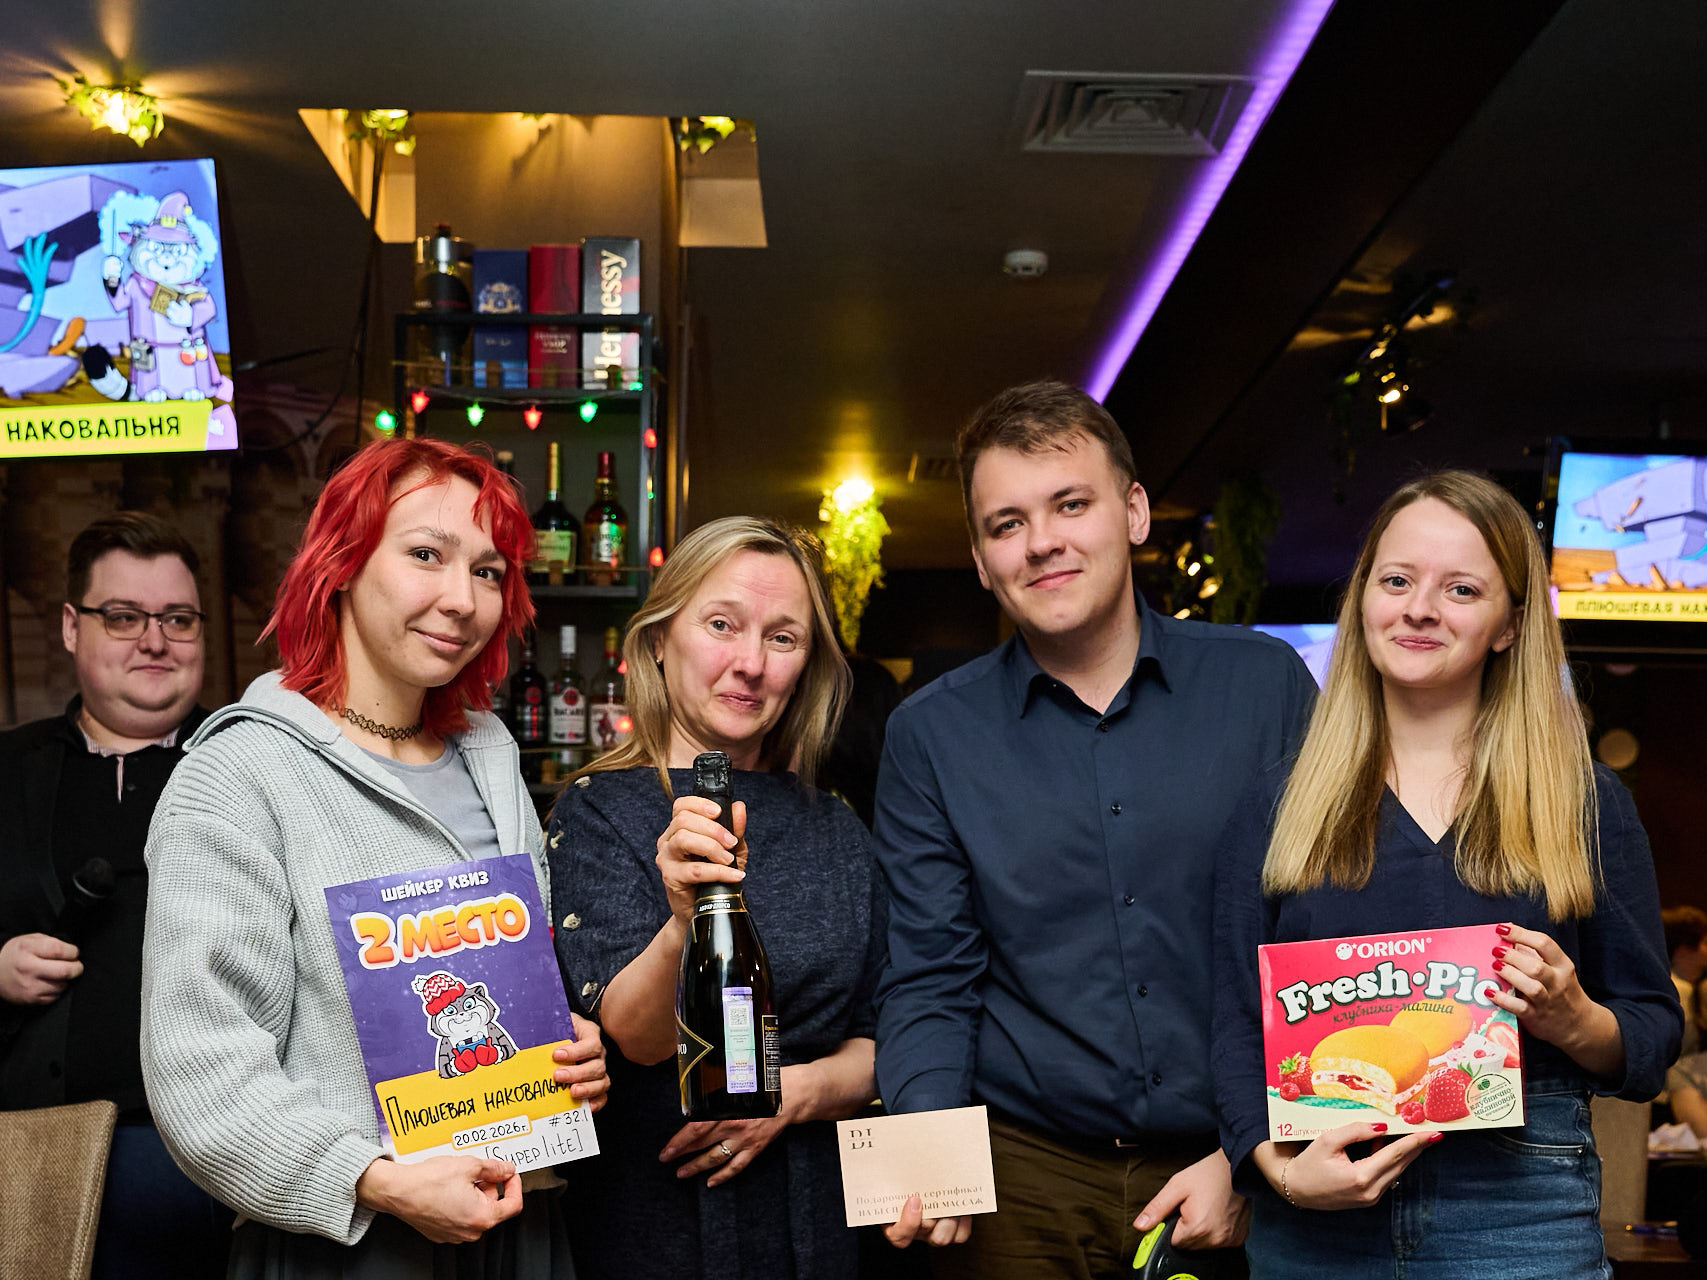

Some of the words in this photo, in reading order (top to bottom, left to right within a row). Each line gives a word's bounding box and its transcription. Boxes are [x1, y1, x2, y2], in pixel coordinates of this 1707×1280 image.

[7, 416, 180, 441] НАКОВАЛЬНЯ
[381, 878, 444, 902] ШЕЙКЕР
[448, 871, 489, 891] КВИЗ
[356, 917, 395, 964] 2
[402, 898, 526, 958] МЕСТО
[1277, 1123, 1293, 1136] 12
[942, 1198, 983, 1210] МАССАЖ
